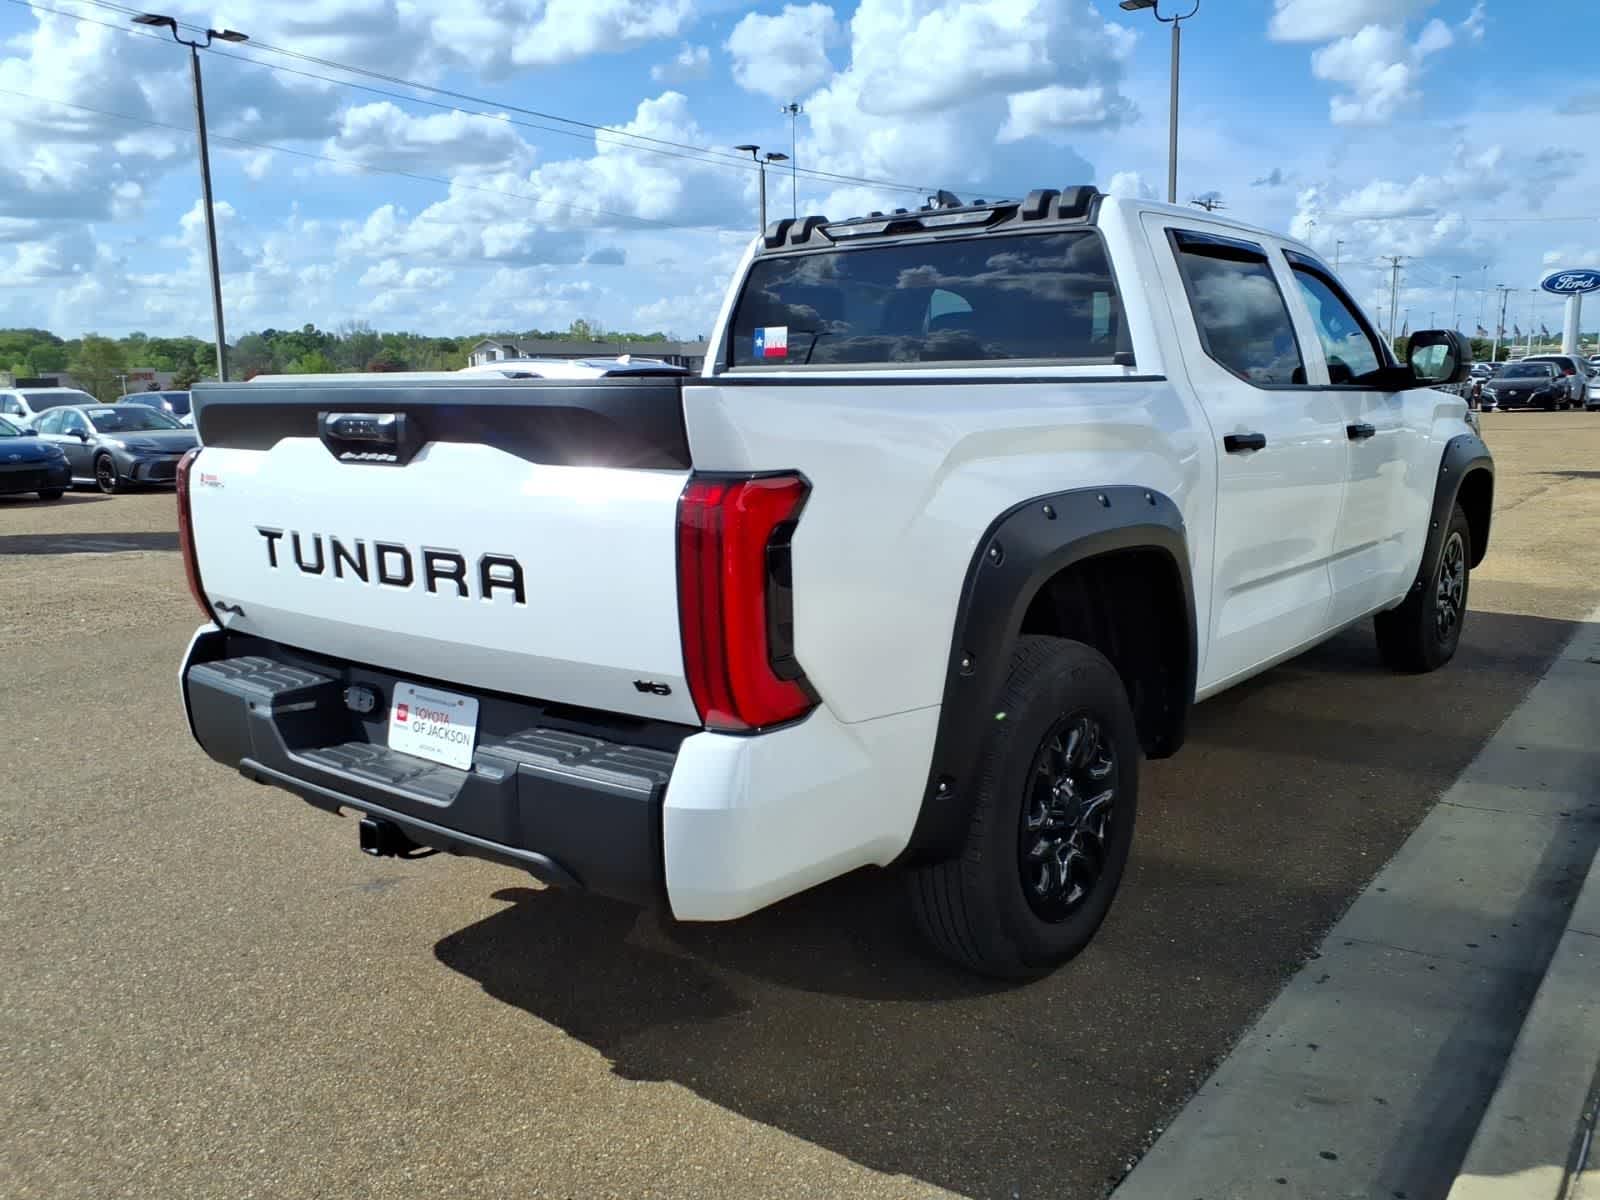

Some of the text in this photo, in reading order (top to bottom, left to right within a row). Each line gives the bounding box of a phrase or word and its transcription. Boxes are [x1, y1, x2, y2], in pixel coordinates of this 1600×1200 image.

[1554, 274, 1594, 290] Ford
[255, 525, 527, 605] TUNDRA
[415, 706, 450, 724] TOYOTA
[412, 721, 426, 733] OF
[427, 724, 472, 745] JACKSON
